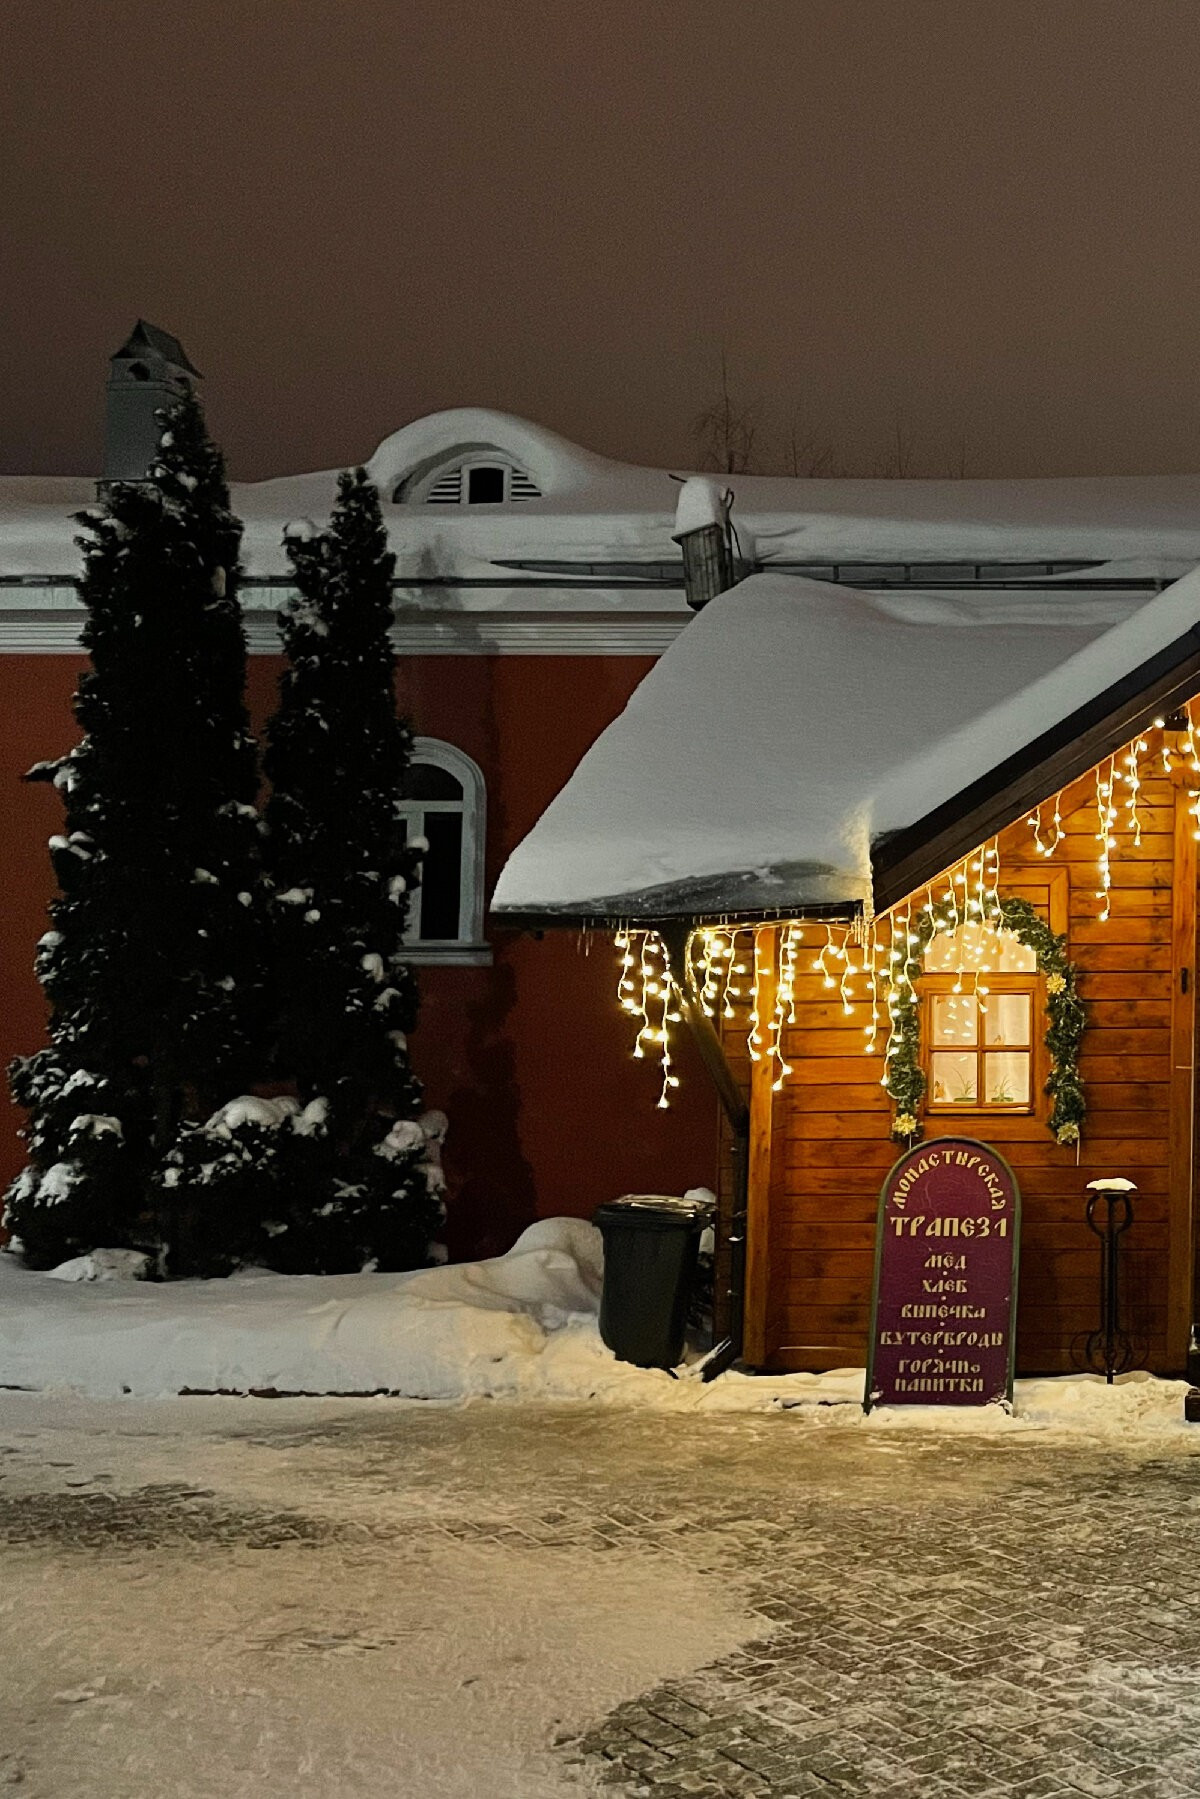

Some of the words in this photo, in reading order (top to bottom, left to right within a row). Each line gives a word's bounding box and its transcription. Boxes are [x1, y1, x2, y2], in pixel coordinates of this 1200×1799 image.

[892, 1150, 1006, 1210] МОНАСТЫРСКАЯ
[922, 1279, 968, 1293] ХЛЕБ
[901, 1304, 986, 1318] ВЫПЕЧКА
[880, 1331, 1003, 1348] БУТЕРБРОДЫ
[898, 1358, 981, 1373] ГОРЯЧИЕ
[895, 1378, 984, 1392] НАПИТКИ
